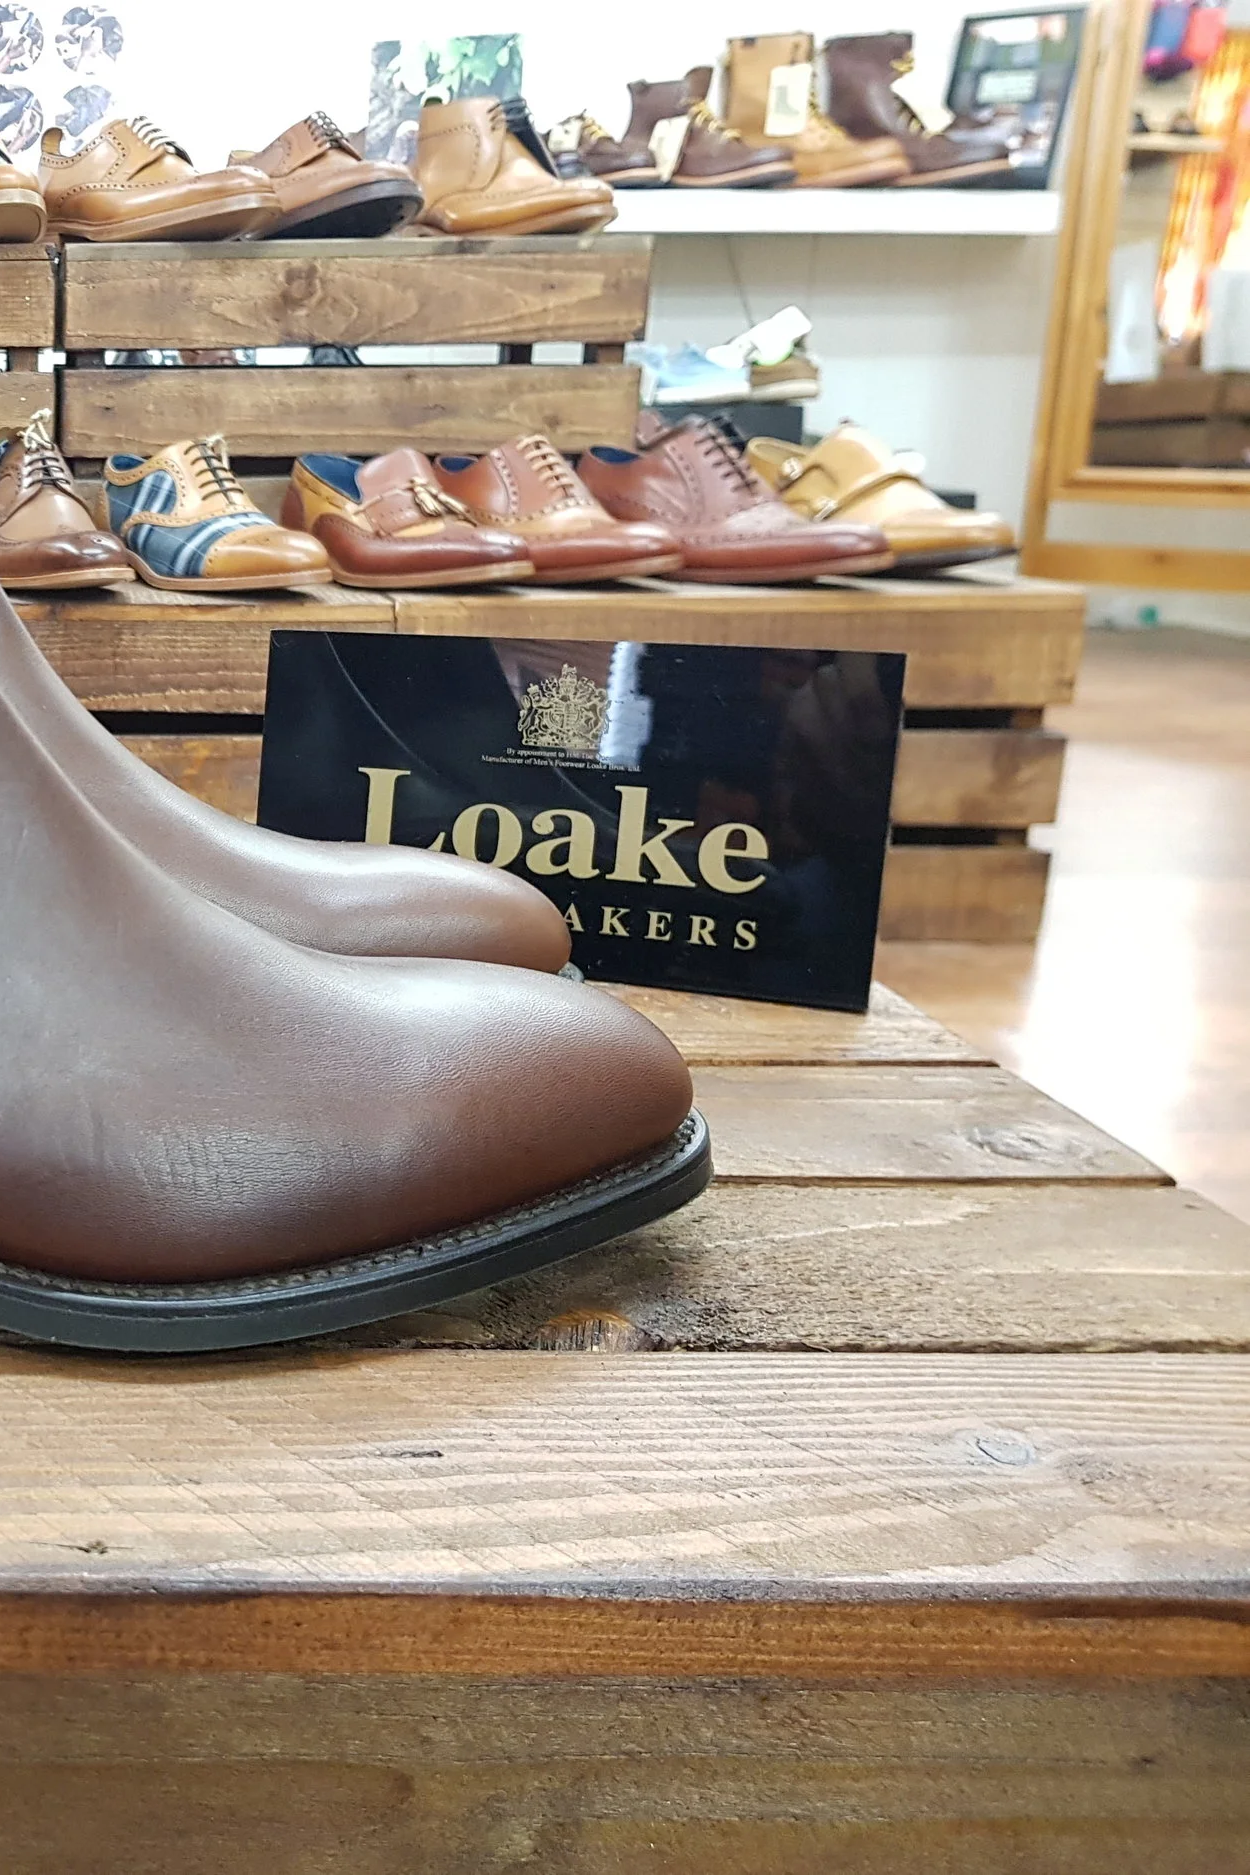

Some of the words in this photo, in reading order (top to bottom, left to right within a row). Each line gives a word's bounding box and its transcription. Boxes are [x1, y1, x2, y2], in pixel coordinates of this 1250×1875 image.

[481, 754, 523, 764] Manufacturer
[554, 759, 586, 768] Footwear
[586, 762, 608, 770] Loake
[507, 747, 515, 756] By
[517, 749, 557, 758] appointment
[357, 766, 770, 894] Loake
[562, 902, 759, 951] AKERS
